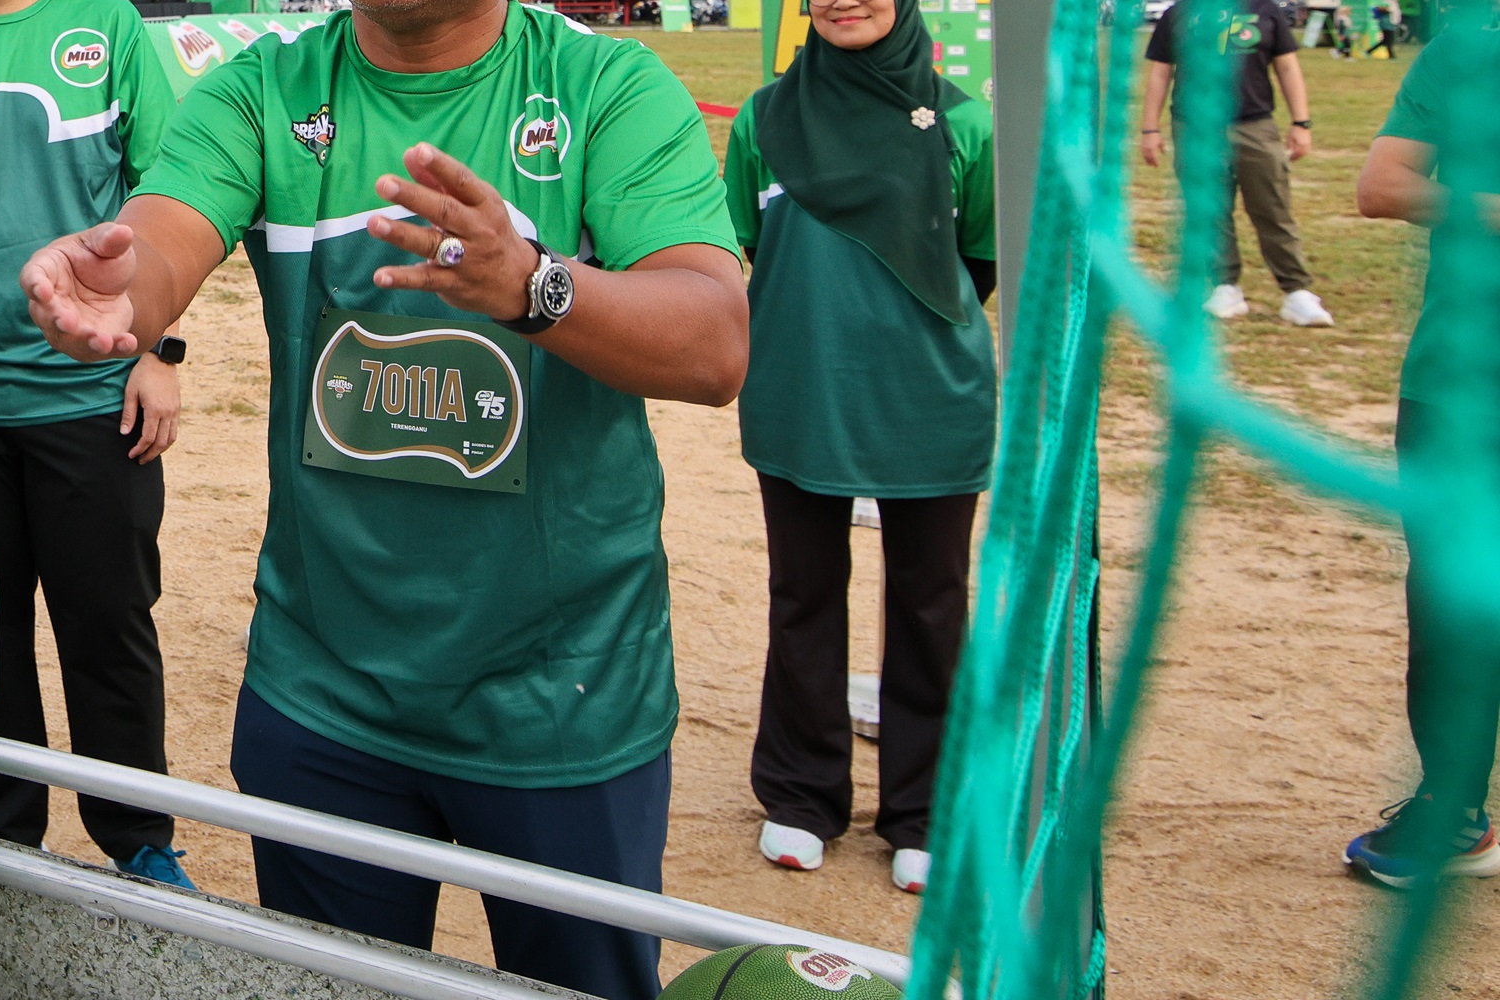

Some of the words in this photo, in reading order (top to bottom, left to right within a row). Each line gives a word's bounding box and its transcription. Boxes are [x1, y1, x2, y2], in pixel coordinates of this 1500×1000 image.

[178, 30, 215, 61] MILO
[67, 50, 102, 63] MILO
[526, 127, 556, 147] MIL
[361, 359, 467, 423] 7011A
[477, 396, 506, 419] 75
[390, 422, 428, 433] TERENGGANU
